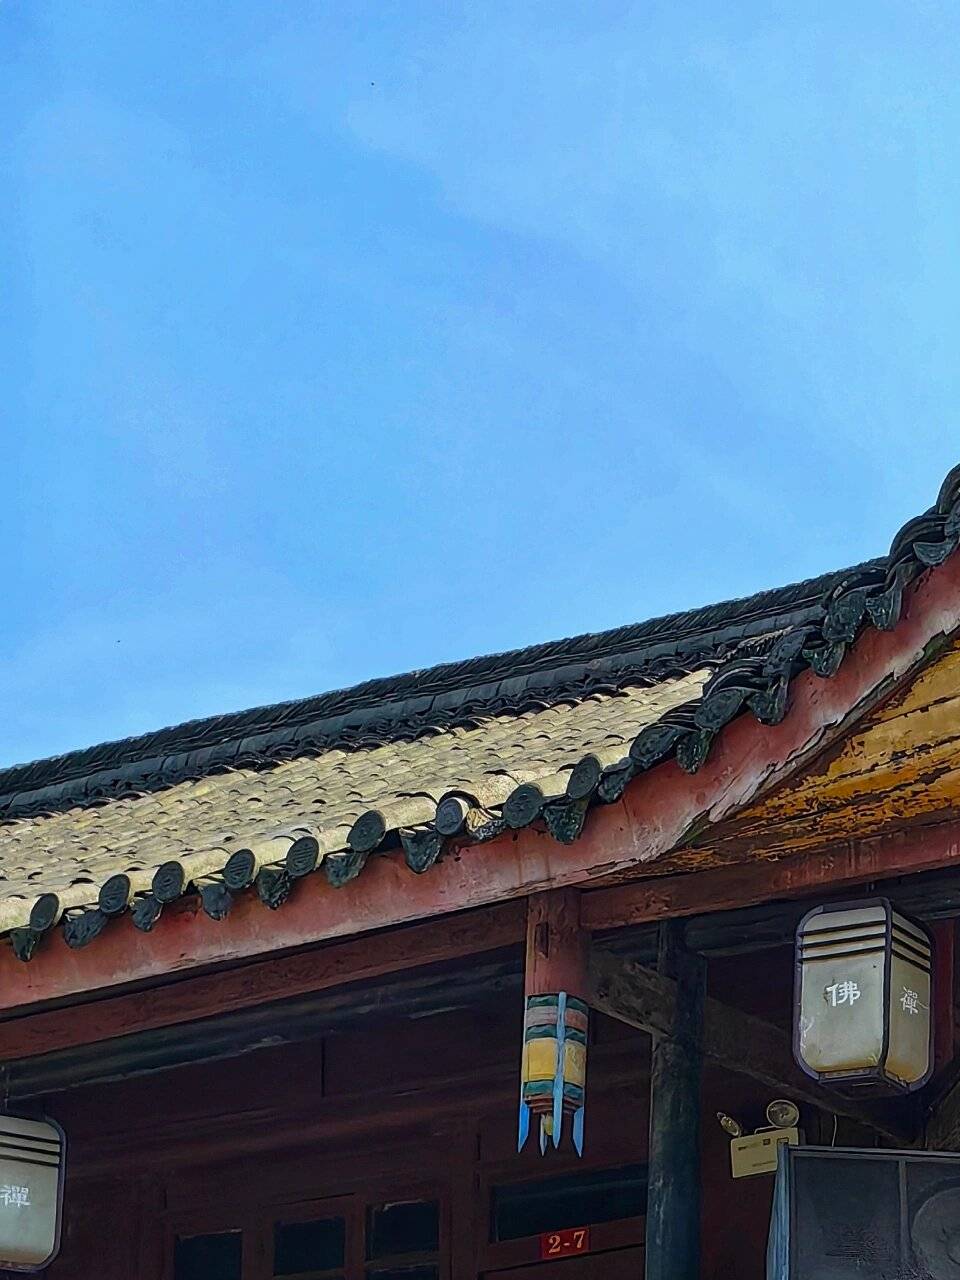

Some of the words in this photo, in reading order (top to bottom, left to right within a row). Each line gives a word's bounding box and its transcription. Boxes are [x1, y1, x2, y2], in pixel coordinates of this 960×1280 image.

[826, 980, 861, 1007] 佛
[900, 986, 919, 1015] 禪
[548, 1230, 586, 1254] 2-7
